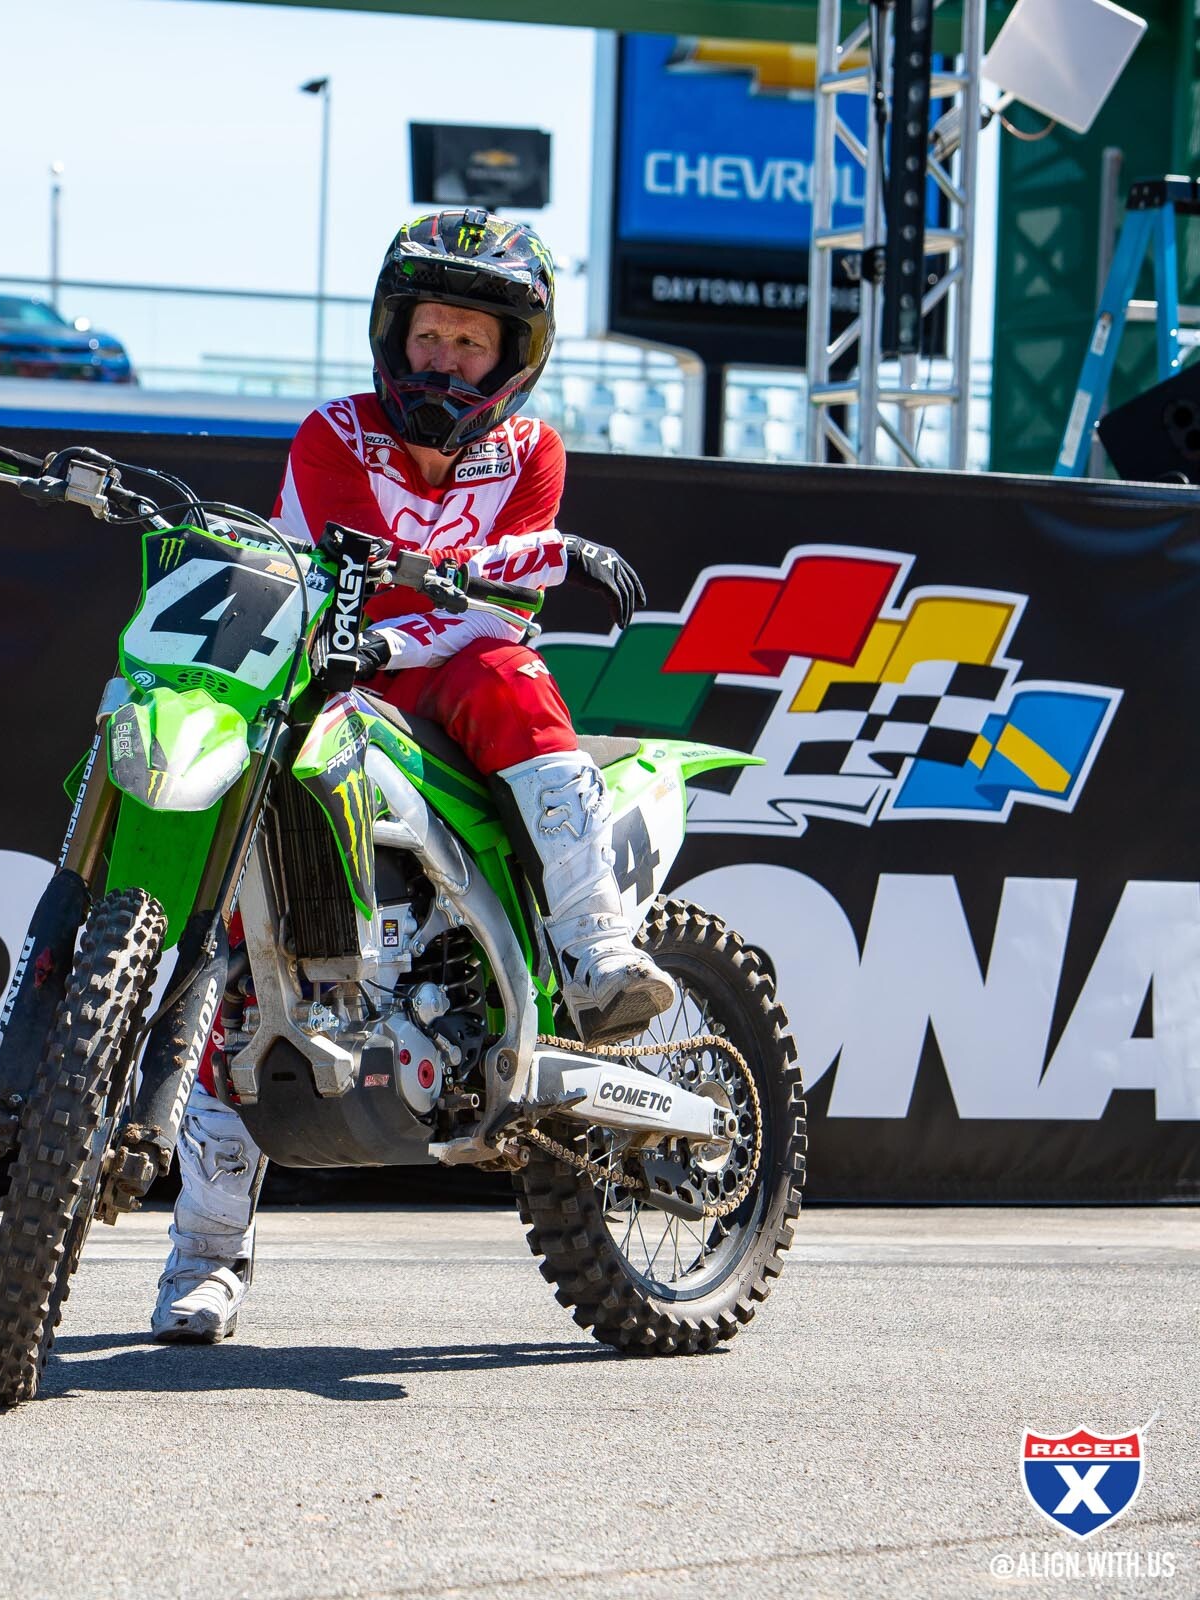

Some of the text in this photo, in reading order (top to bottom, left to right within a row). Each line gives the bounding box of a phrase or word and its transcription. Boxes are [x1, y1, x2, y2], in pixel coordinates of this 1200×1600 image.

[644, 152, 866, 206] CHEVROL
[652, 275, 761, 306] DAYTONA
[465, 442, 506, 456] LICK
[457, 462, 511, 479] COMETIC
[480, 542, 565, 583] FOX
[563, 536, 618, 569] FOX
[332, 553, 364, 652] OAKLEY
[149, 565, 280, 674] 4
[516, 659, 550, 679] FO
[327, 747, 353, 775] PRO
[611, 805, 661, 906] 4
[169, 977, 218, 1136] DUNLOP
[599, 1082, 673, 1113] COMETIC
